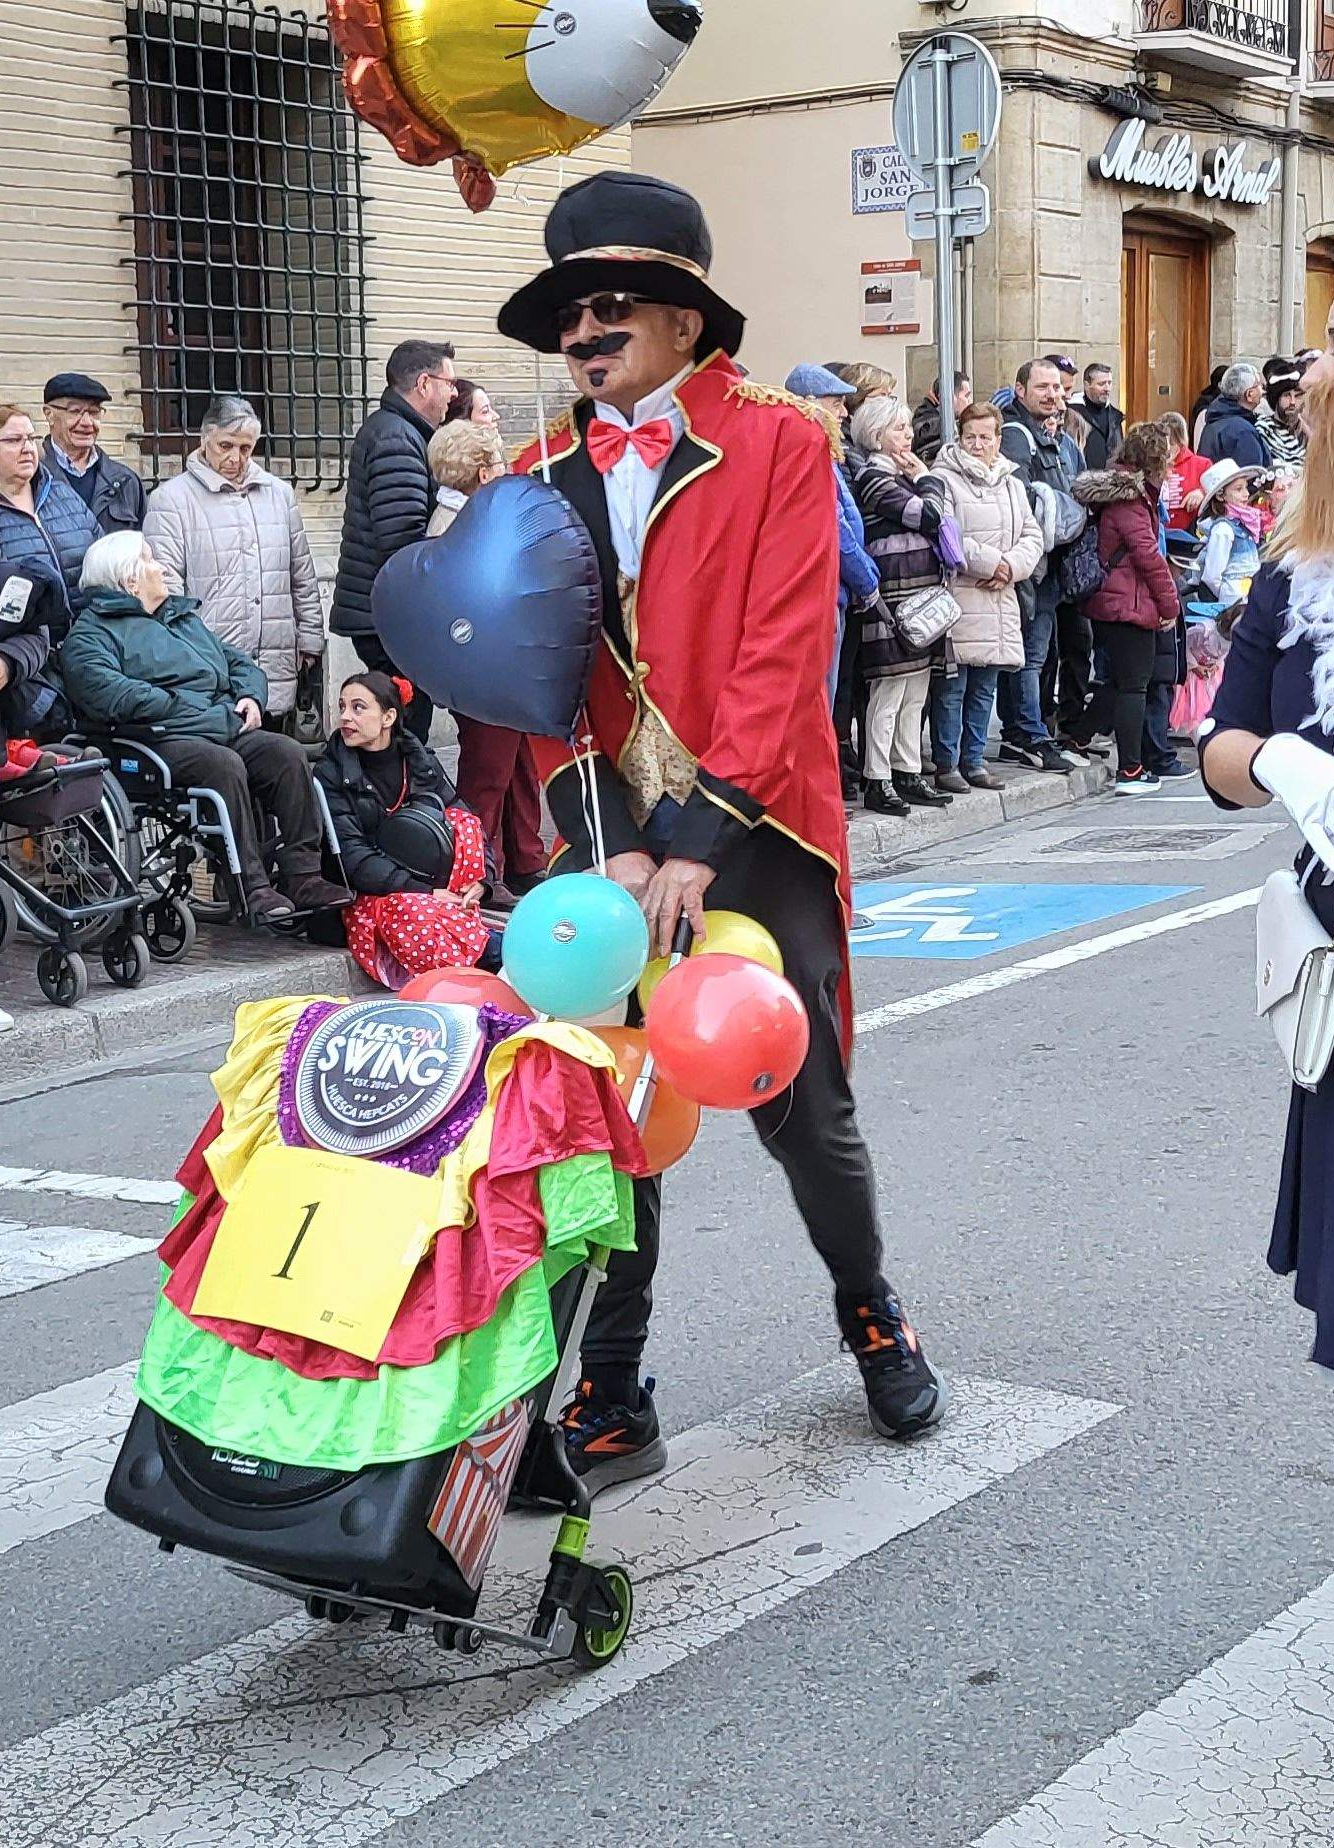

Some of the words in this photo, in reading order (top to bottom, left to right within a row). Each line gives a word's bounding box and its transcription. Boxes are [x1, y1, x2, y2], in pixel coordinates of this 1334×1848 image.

[879, 168, 911, 185] SAN
[1099, 117, 1197, 193] Muebles
[1203, 141, 1281, 205] Arnal
[861, 184, 920, 202] JORGE
[317, 1035, 449, 1086] SWING
[327, 1083, 357, 1119] HUESCA
[357, 1093, 409, 1120] HEPCATS
[271, 1201, 321, 1280] 1
